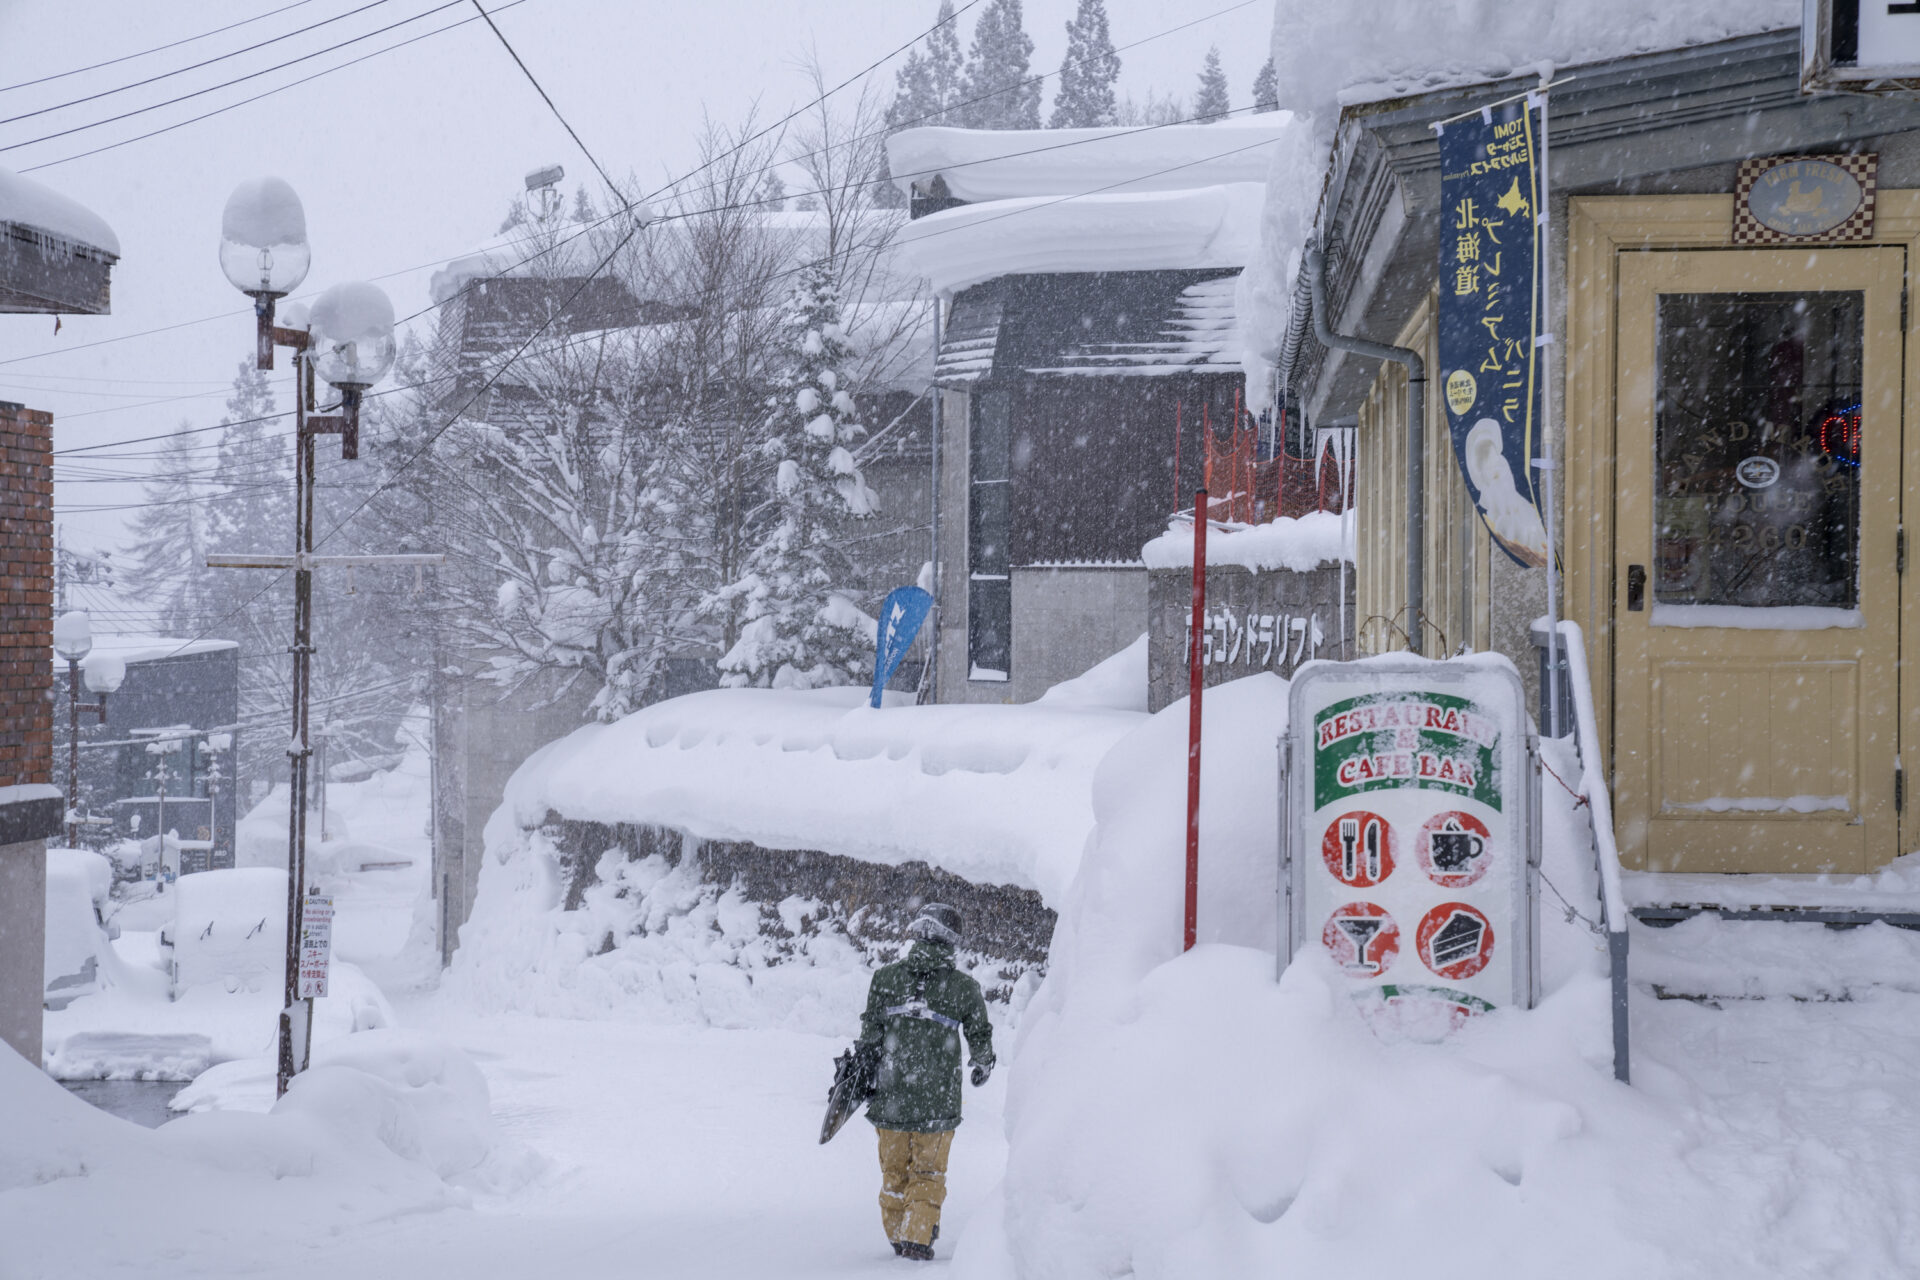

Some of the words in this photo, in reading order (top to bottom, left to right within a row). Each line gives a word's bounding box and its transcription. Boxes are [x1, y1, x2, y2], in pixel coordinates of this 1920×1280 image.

[1764, 165, 1799, 187] FARM
[1805, 163, 1845, 185] FRESH
[1698, 525, 1808, 550] 4260
[1339, 754, 1410, 785] CAFE
[1419, 755, 1474, 786] BAR
[307, 950, 323, 958] スキー
